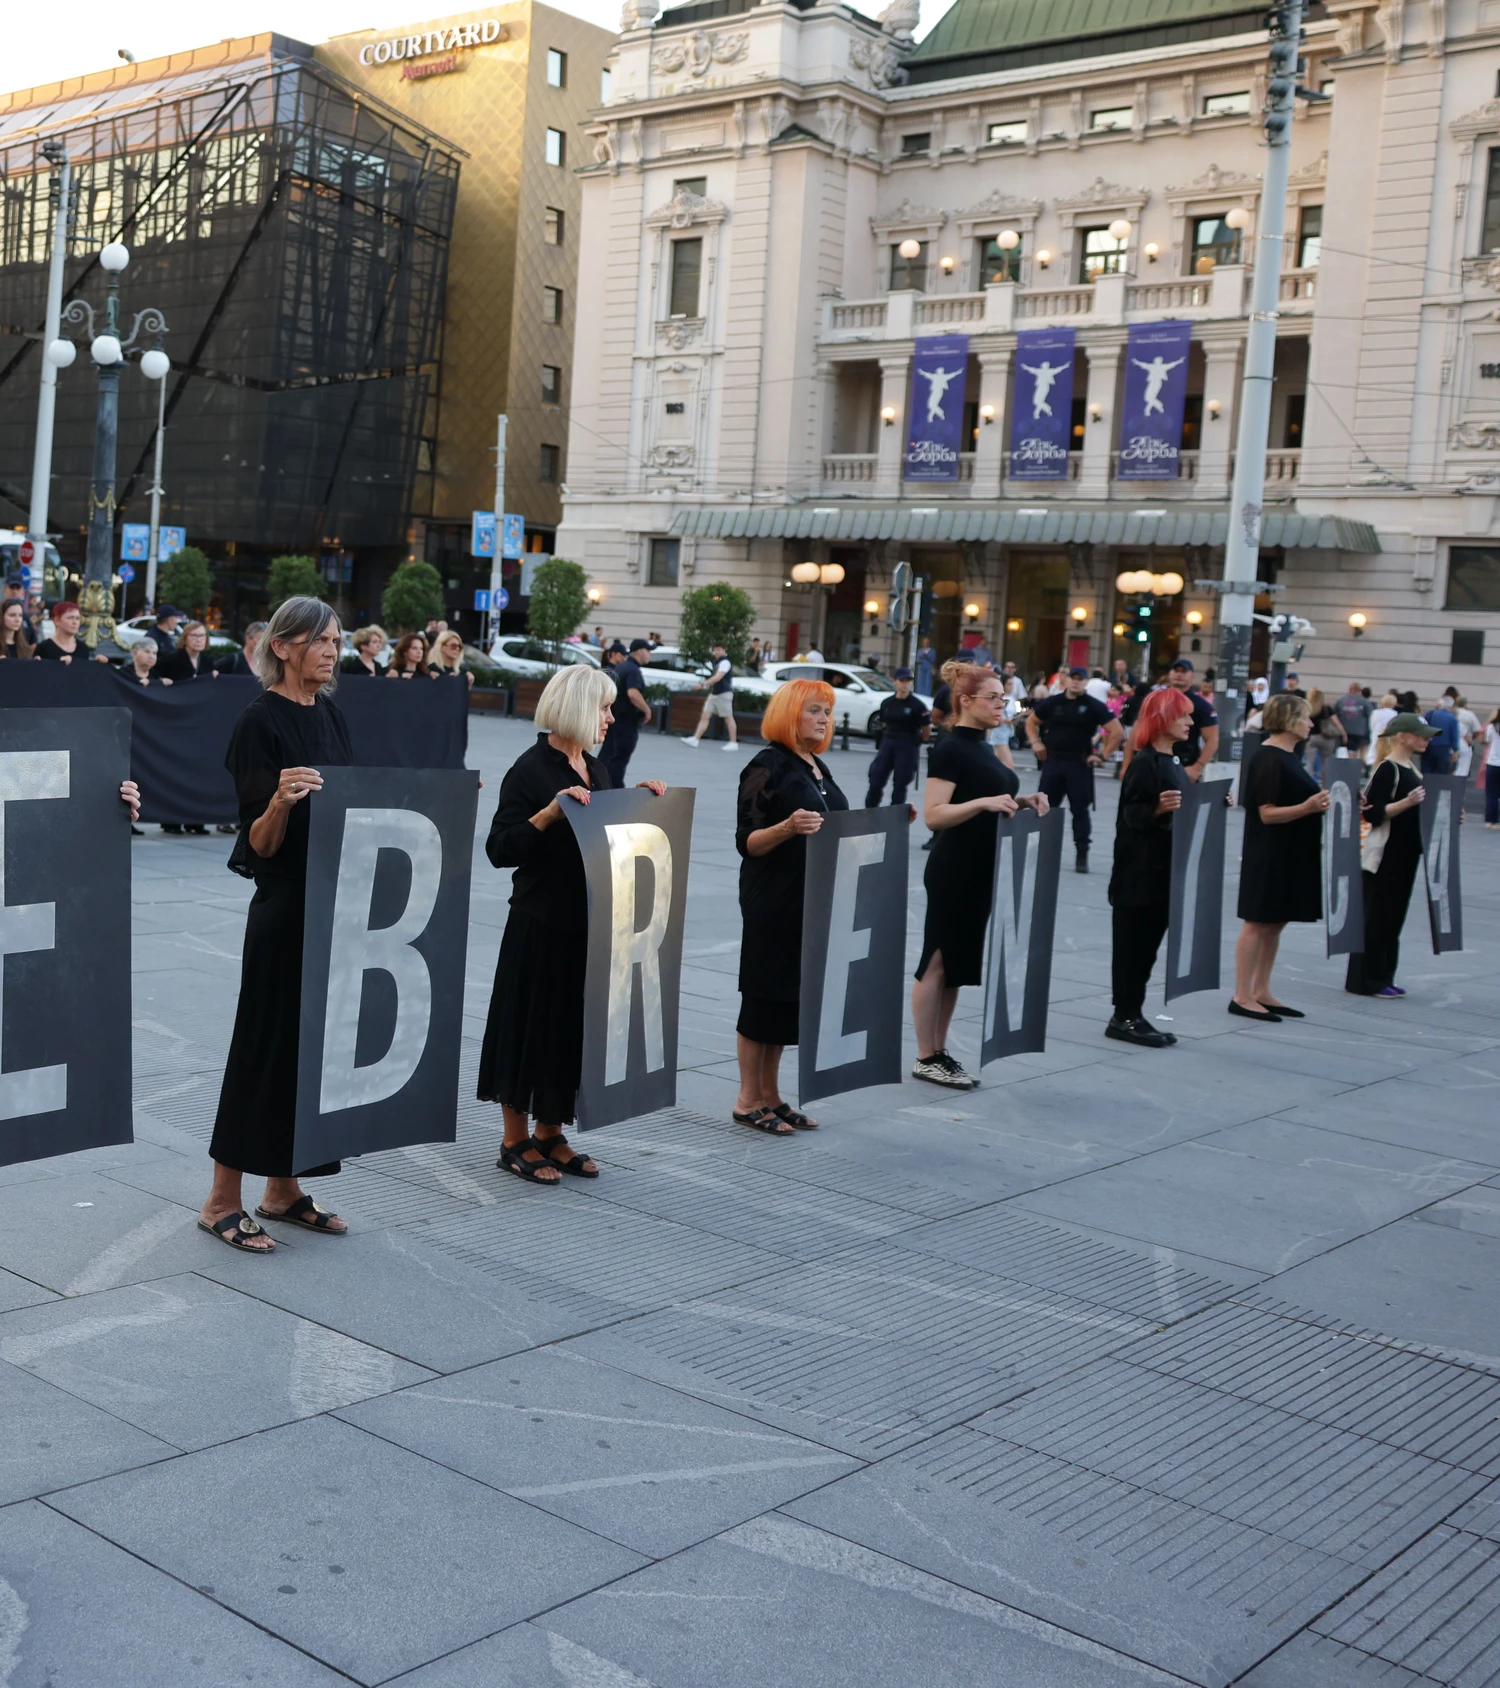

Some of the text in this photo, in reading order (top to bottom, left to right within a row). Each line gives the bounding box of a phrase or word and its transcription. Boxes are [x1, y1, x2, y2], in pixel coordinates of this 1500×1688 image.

[359, 19, 500, 66] COURTYARD
[1121, 436, 1177, 463] Зорба
[21, 548, 34, 557] STOP
[984, 831, 1040, 1042] N
[1177, 802, 1212, 979] I
[1319, 780, 1352, 937] C
[1427, 790, 1452, 934] A
[319, 808, 443, 1114] B
[604, 822, 673, 1087] R
[815, 832, 887, 1072] E
